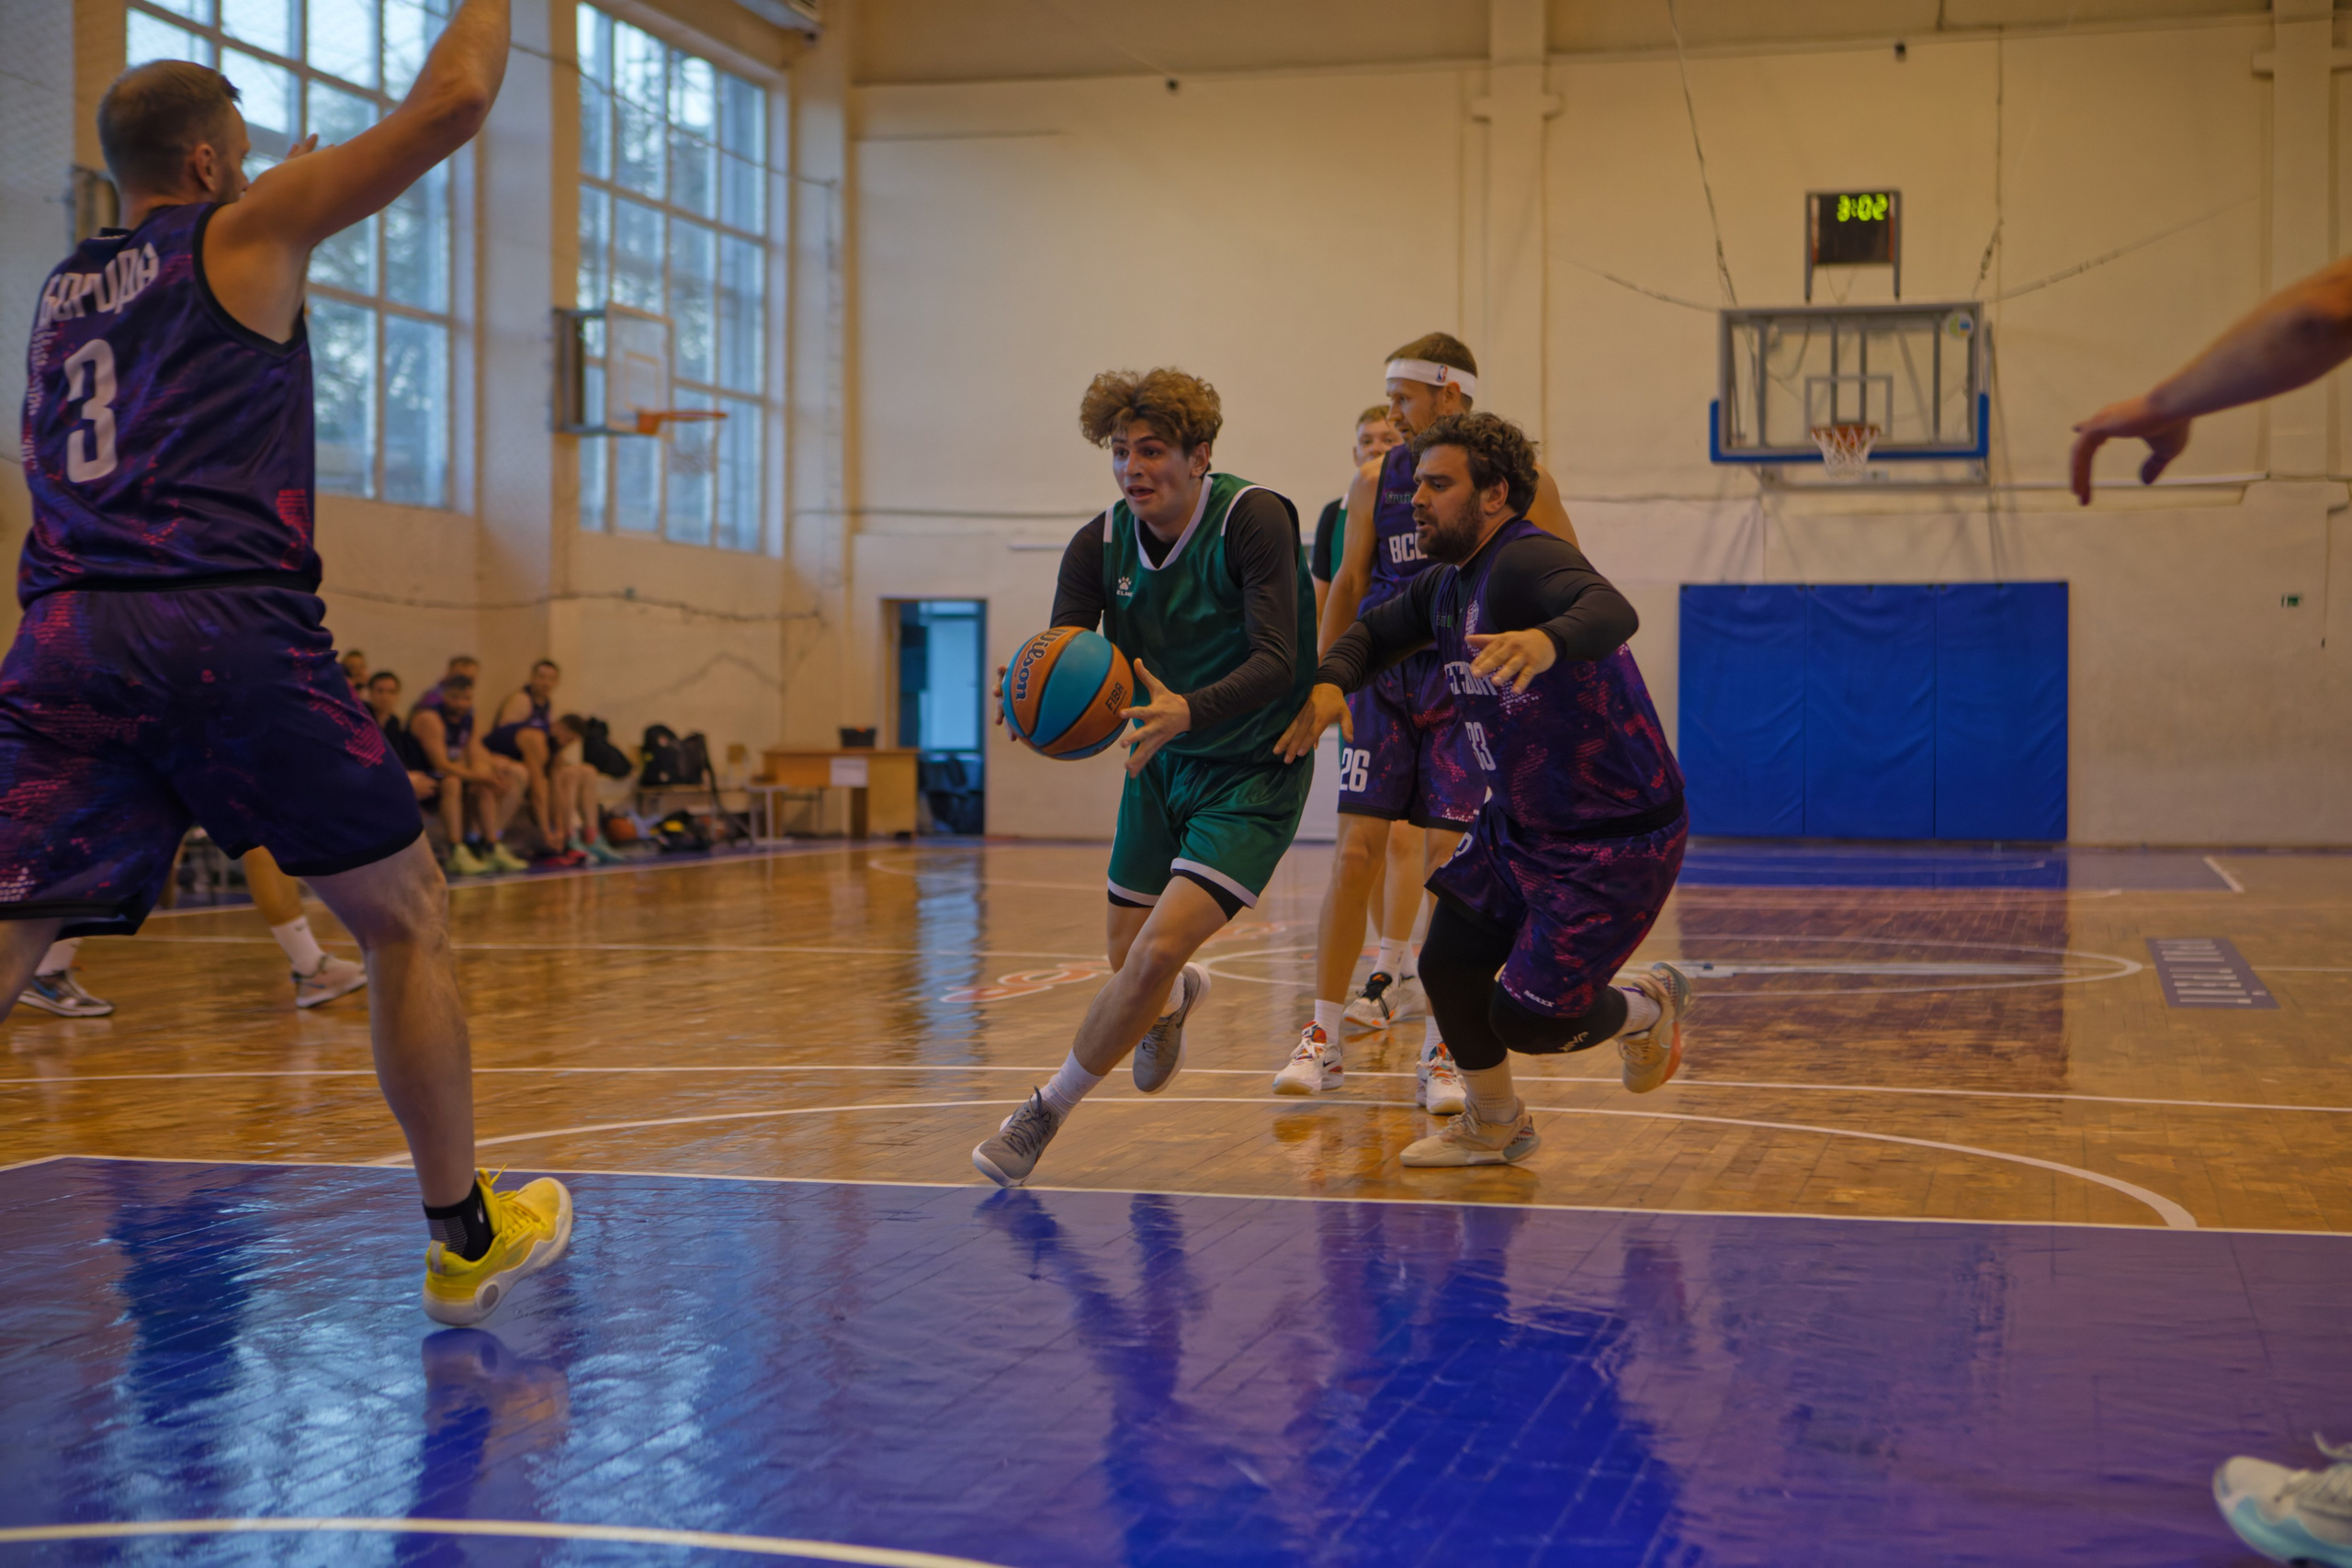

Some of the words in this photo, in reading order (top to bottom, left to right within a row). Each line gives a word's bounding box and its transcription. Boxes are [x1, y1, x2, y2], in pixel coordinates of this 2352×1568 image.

[1837, 194, 1888, 221] 3:02
[64, 339, 118, 483] 3
[1015, 629, 1069, 700] Wilson
[1105, 682, 1124, 711] FIBA
[1340, 748, 1370, 793] 26
